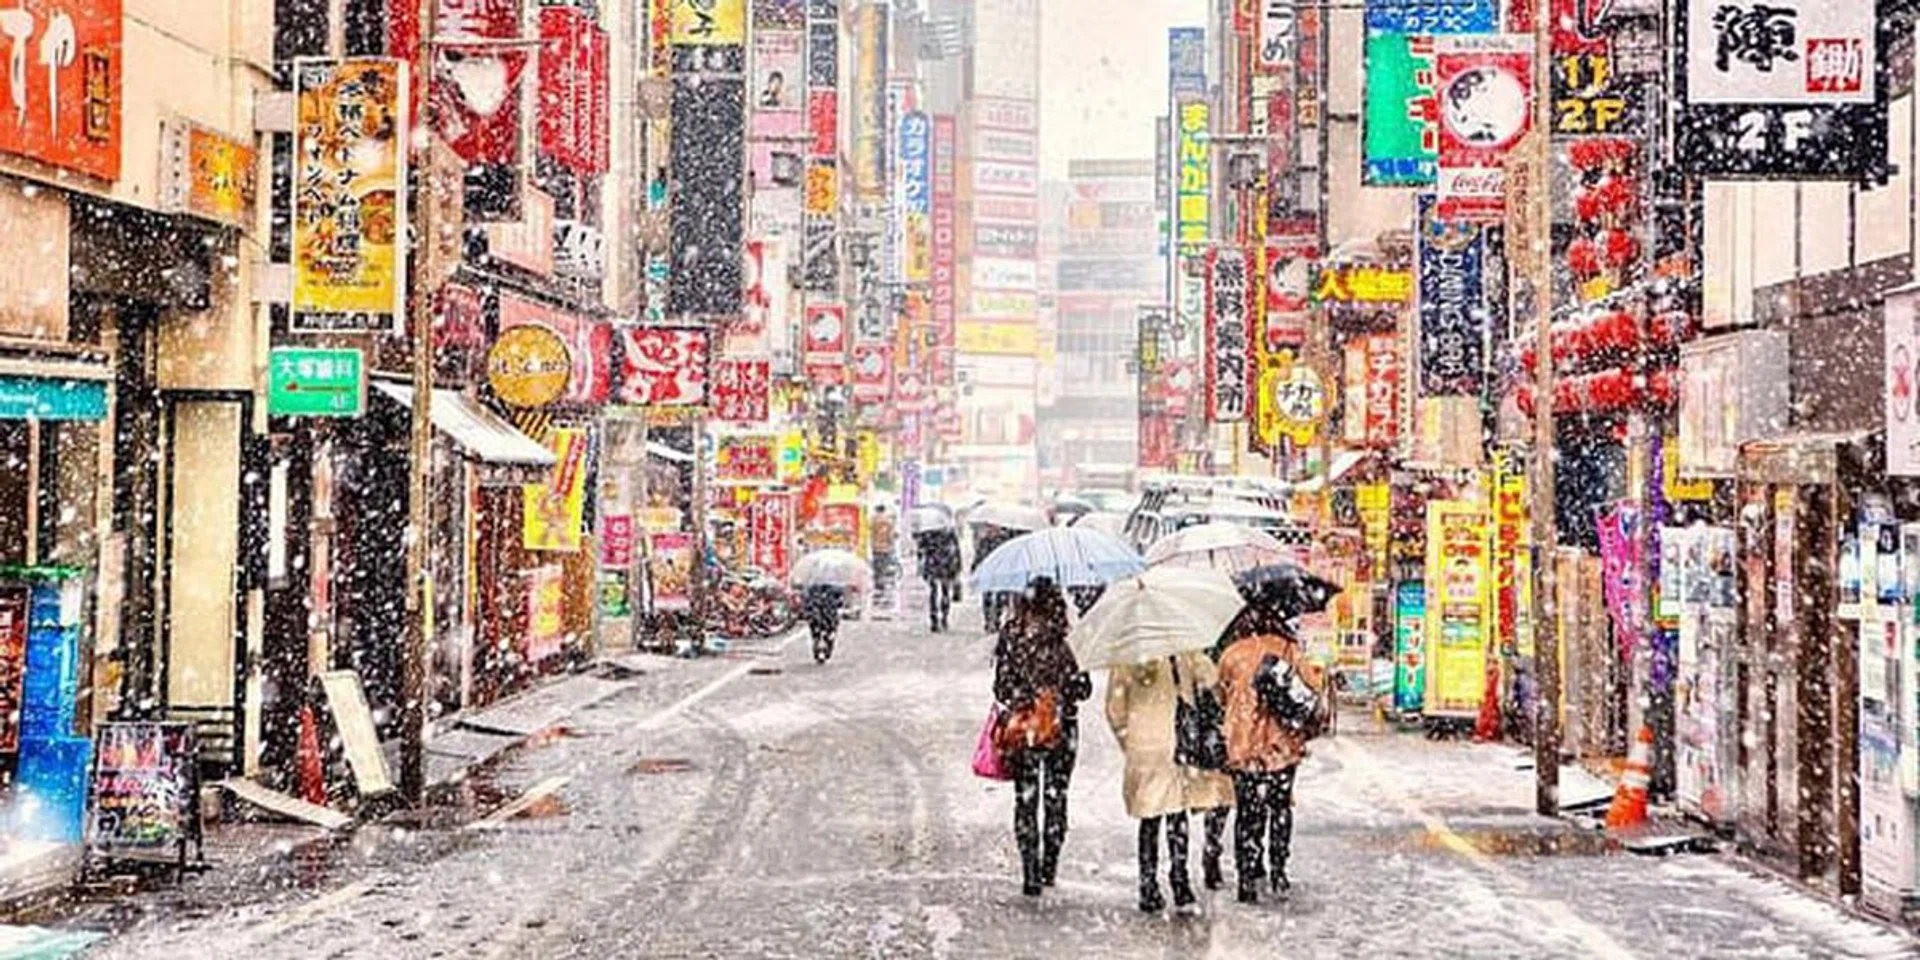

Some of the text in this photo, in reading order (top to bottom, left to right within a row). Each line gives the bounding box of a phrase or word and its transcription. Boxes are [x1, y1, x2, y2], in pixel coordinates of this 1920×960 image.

[1556, 98, 1624, 130] 2F
[1737, 111, 1813, 151] 2F
[1213, 257, 1244, 412] 無料案内所
